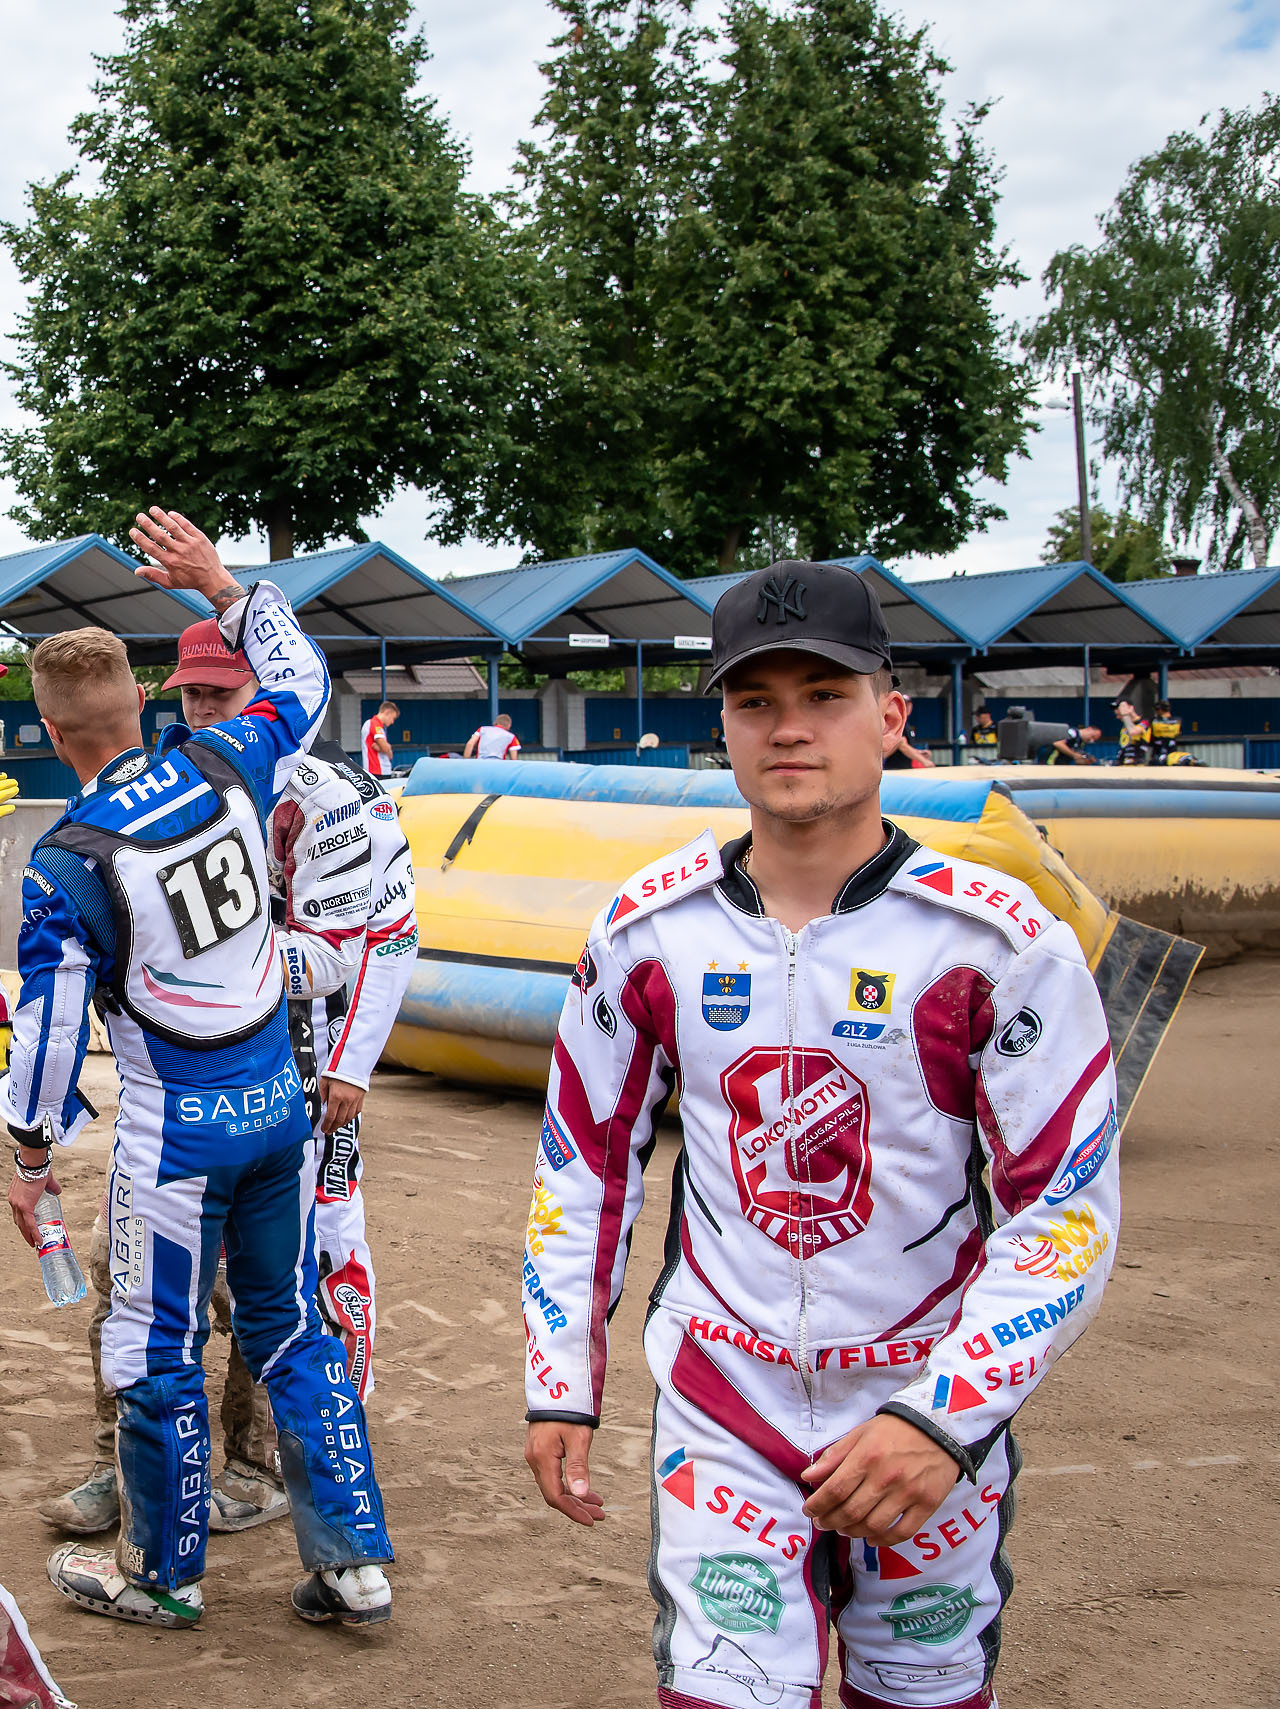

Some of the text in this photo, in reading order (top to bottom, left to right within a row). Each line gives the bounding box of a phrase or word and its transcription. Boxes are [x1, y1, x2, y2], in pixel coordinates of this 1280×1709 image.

[757, 573, 807, 624] NY
[164, 839, 261, 950] 13
[321, 892, 352, 911] NORTH
[641, 851, 709, 899] SELS
[963, 880, 1042, 939] SELS
[841, 1024, 868, 1039] 2LŻ
[861, 1000, 880, 1010] PZM
[179, 1060, 300, 1122] SAGARI
[228, 1105, 289, 1135] SPORTS
[741, 1073, 849, 1162] LOKOMOTIV
[798, 1102, 862, 1152] DAUGAVPILS
[838, 1116, 860, 1134] CLUB
[133, 1218, 144, 1284] SPORTS
[787, 1232, 822, 1245] 1963
[991, 1283, 1086, 1348] BERNER
[528, 1335, 570, 1400] SELS
[321, 1408, 345, 1484] SPORTS
[324, 1361, 376, 1530] SAGARI
[173, 1400, 203, 1557] SAGARI
[706, 1485, 807, 1561] SELS
[912, 1484, 1002, 1562] SELS
[700, 1566, 774, 1620] LIMBAŽU
